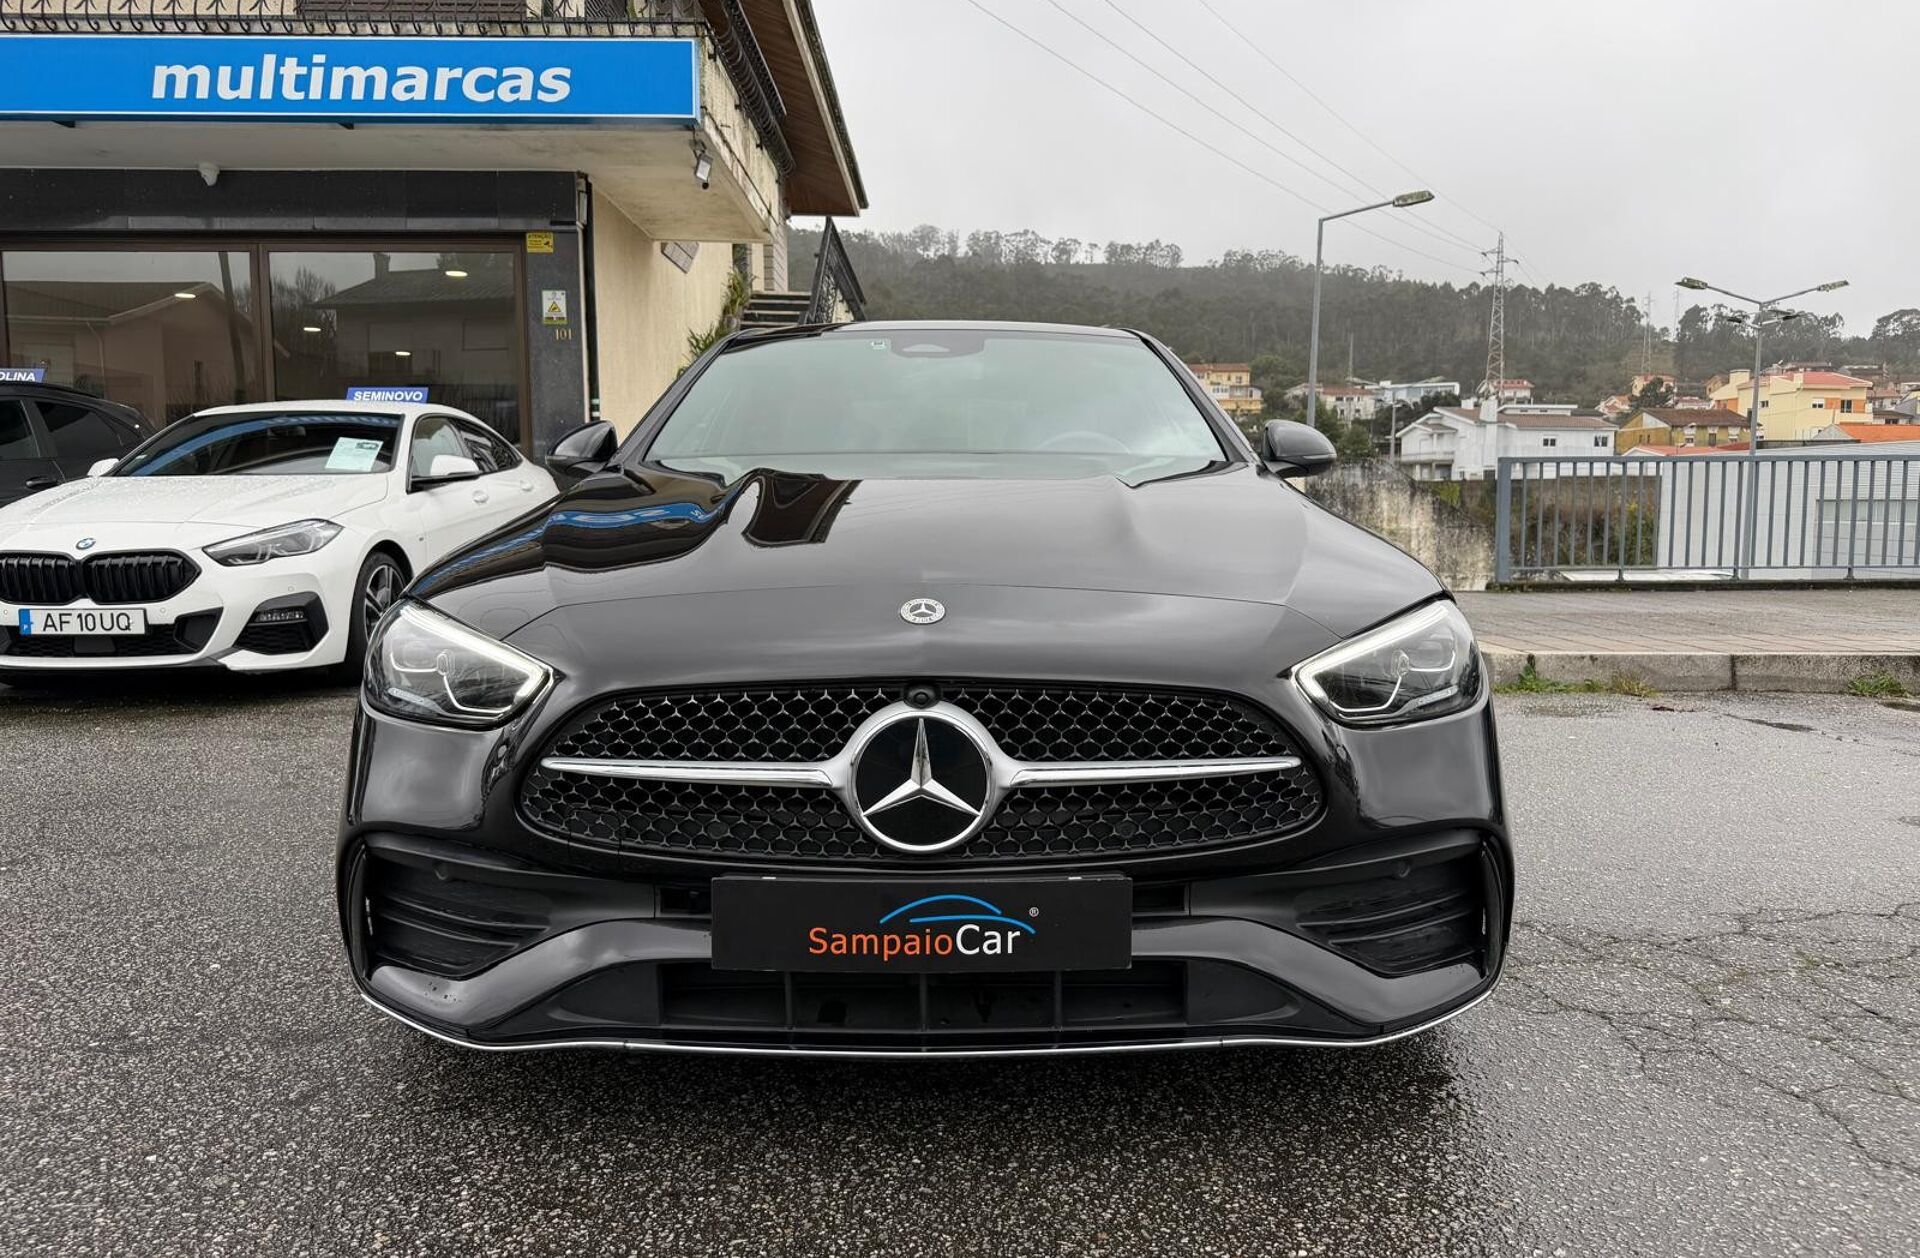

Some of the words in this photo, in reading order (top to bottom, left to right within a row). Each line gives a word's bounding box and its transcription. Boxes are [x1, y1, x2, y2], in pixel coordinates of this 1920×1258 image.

[152, 53, 572, 103] multimarcas
[556, 328, 572, 341] 101
[353, 390, 424, 402] SEMINOVO
[43, 612, 73, 632] AF
[76, 612, 97, 632] 10
[100, 612, 132, 632] UQ
[808, 923, 1021, 962] SampaioCar
